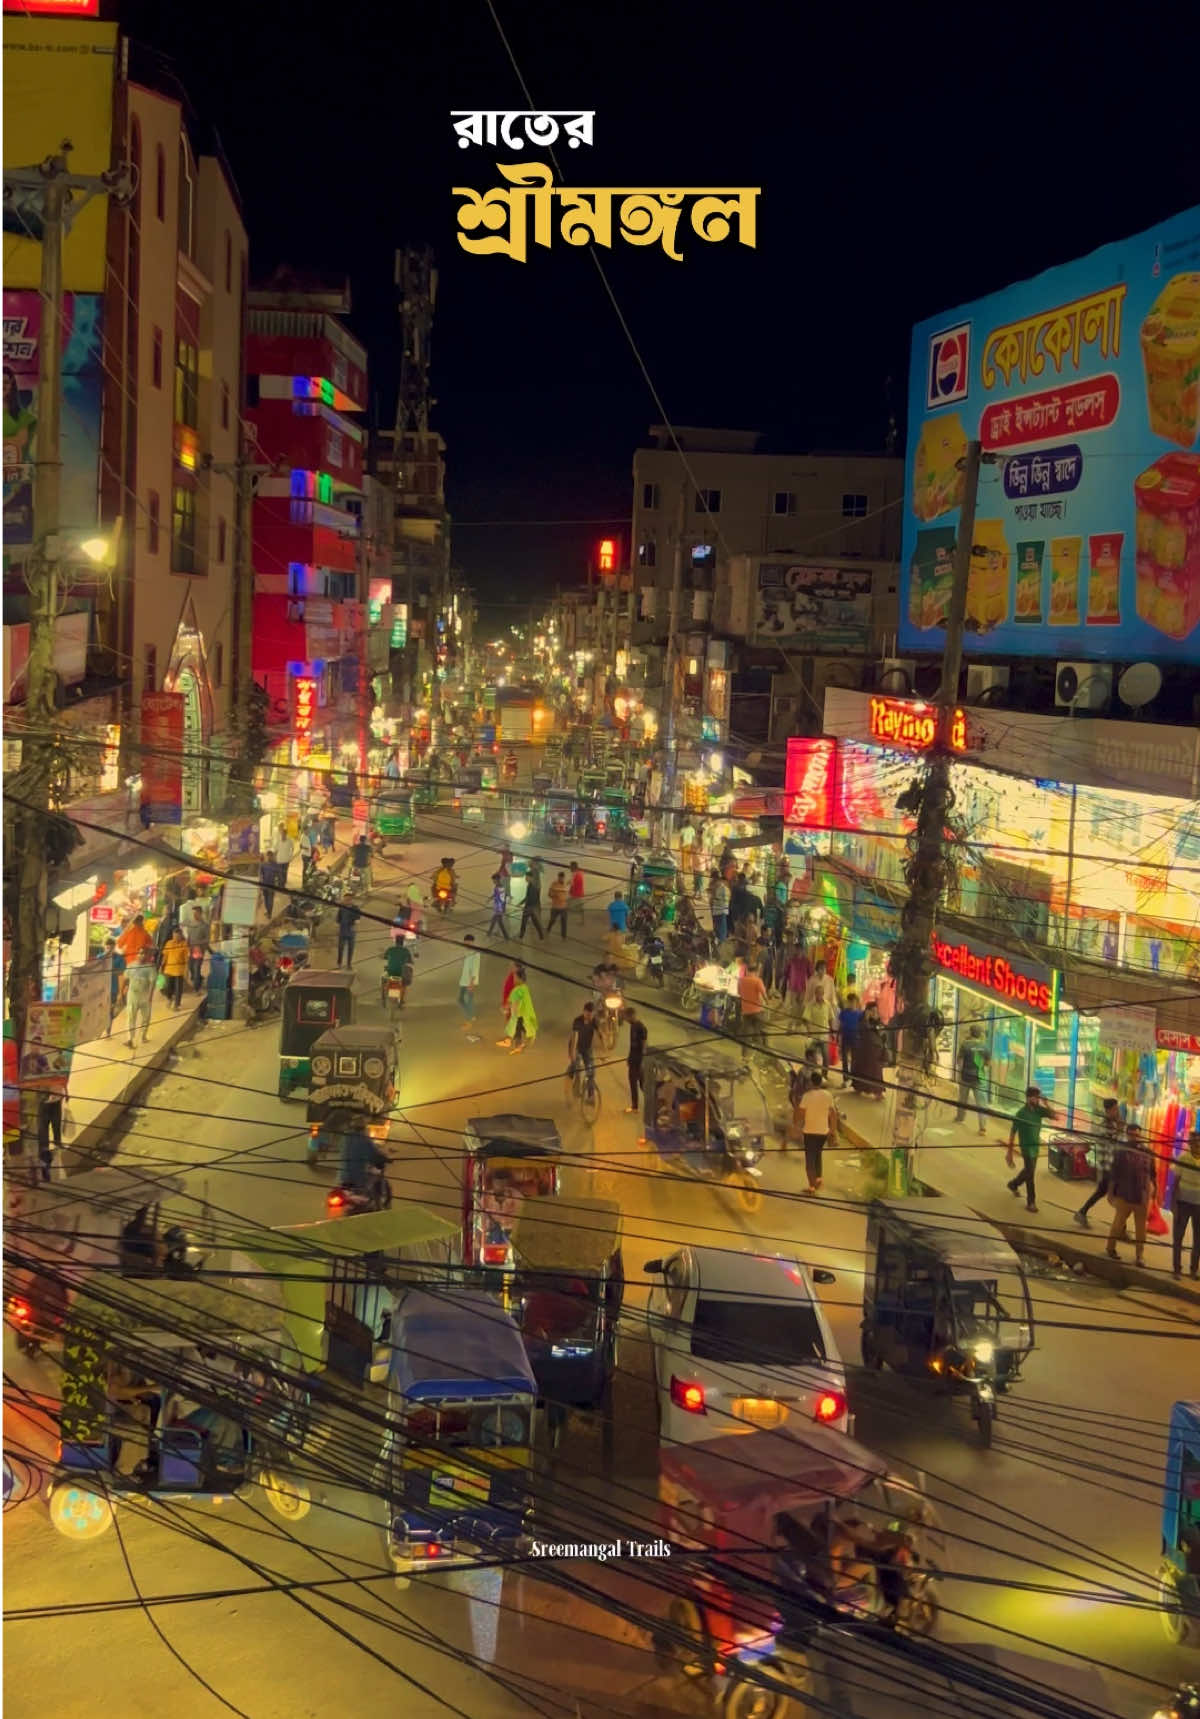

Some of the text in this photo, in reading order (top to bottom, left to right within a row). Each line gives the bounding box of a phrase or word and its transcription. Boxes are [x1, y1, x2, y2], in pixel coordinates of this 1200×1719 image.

[981, 282, 1128, 390] কোকোলা
[1009, 460, 1028, 494] ভিন্ন
[1031, 456, 1050, 492] ভিন্ন
[871, 696, 967, 751] Raymod
[993, 956, 1053, 1013] Shoes
